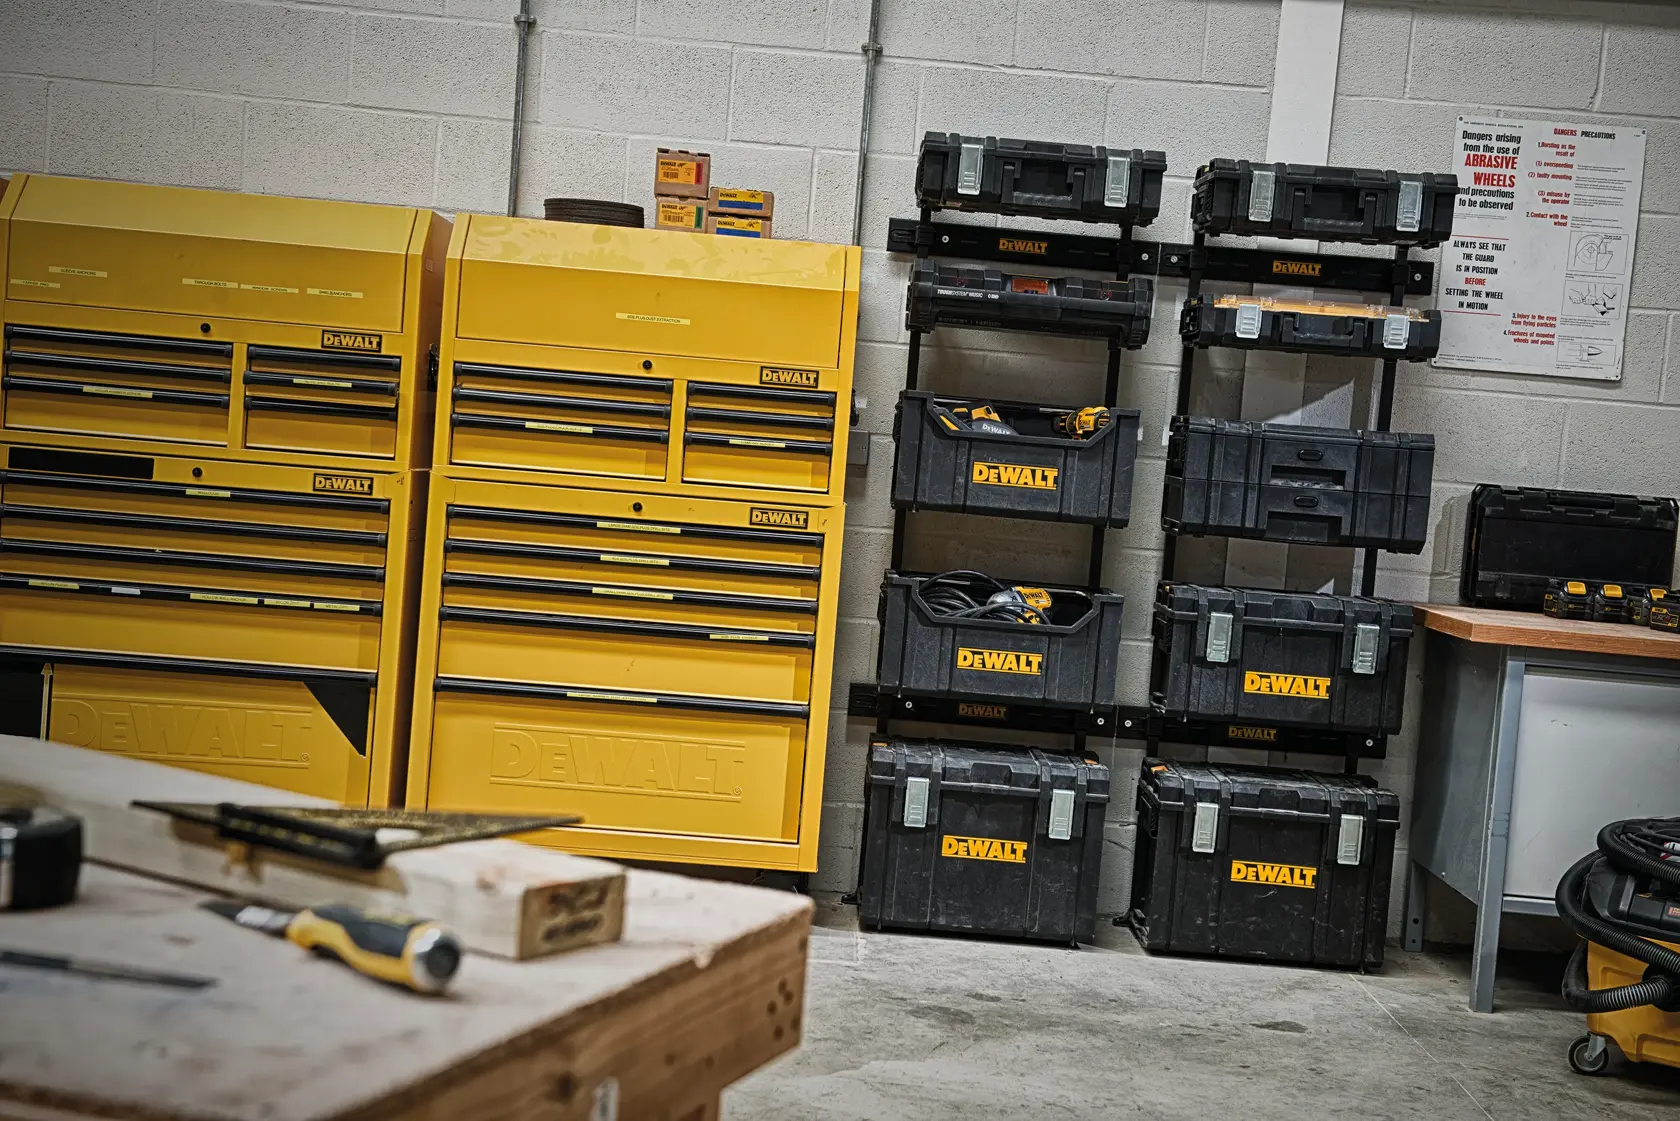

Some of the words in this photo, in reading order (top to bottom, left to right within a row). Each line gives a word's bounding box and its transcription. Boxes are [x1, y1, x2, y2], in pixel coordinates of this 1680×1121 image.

[1462, 130, 1493, 142] Dangers
[1495, 133, 1522, 145] arising
[1553, 128, 1577, 137] DANGERS
[1580, 130, 1616, 140] PRECAUTIONS
[1463, 142, 1481, 152] from
[1482, 143, 1495, 154] the
[1496, 146, 1510, 154] use
[1511, 146, 1521, 156] of
[1464, 152, 1519, 170] ABRASIVE
[1473, 171, 1516, 188] WHEELS
[1550, 173, 1573, 181] mounting
[1460, 186, 1470, 196] nd
[1471, 188, 1515, 199] precautions
[1459, 197, 1467, 207] to
[1467, 198, 1478, 208] be
[1479, 199, 1514, 211] observed
[1453, 240, 1477, 249] ALWAYS
[1478, 242, 1490, 250] SEE
[1491, 243, 1507, 252] THAT
[1462, 252, 1473, 261] THE
[1474, 253, 1495, 263] GUARD
[1455, 264, 1462, 272] IS
[1463, 265, 1470, 273] IN
[1471, 265, 1499, 275] POSITION
[1464, 276, 1487, 286] BEFORE
[1445, 287, 1469, 297] SETTING
[1472, 289, 1483, 298] THE
[1485, 290, 1504, 300] WHEEL
[1458, 300, 1465, 309] IN
[1465, 301, 1489, 311] MOTION
[972, 463, 1058, 489] DEWALT
[957, 649, 1042, 674] DEWALT
[1244, 671, 1330, 698] DEWALT
[941, 835, 1027, 862] DEWALT
[1230, 861, 1316, 888] DEWALT
